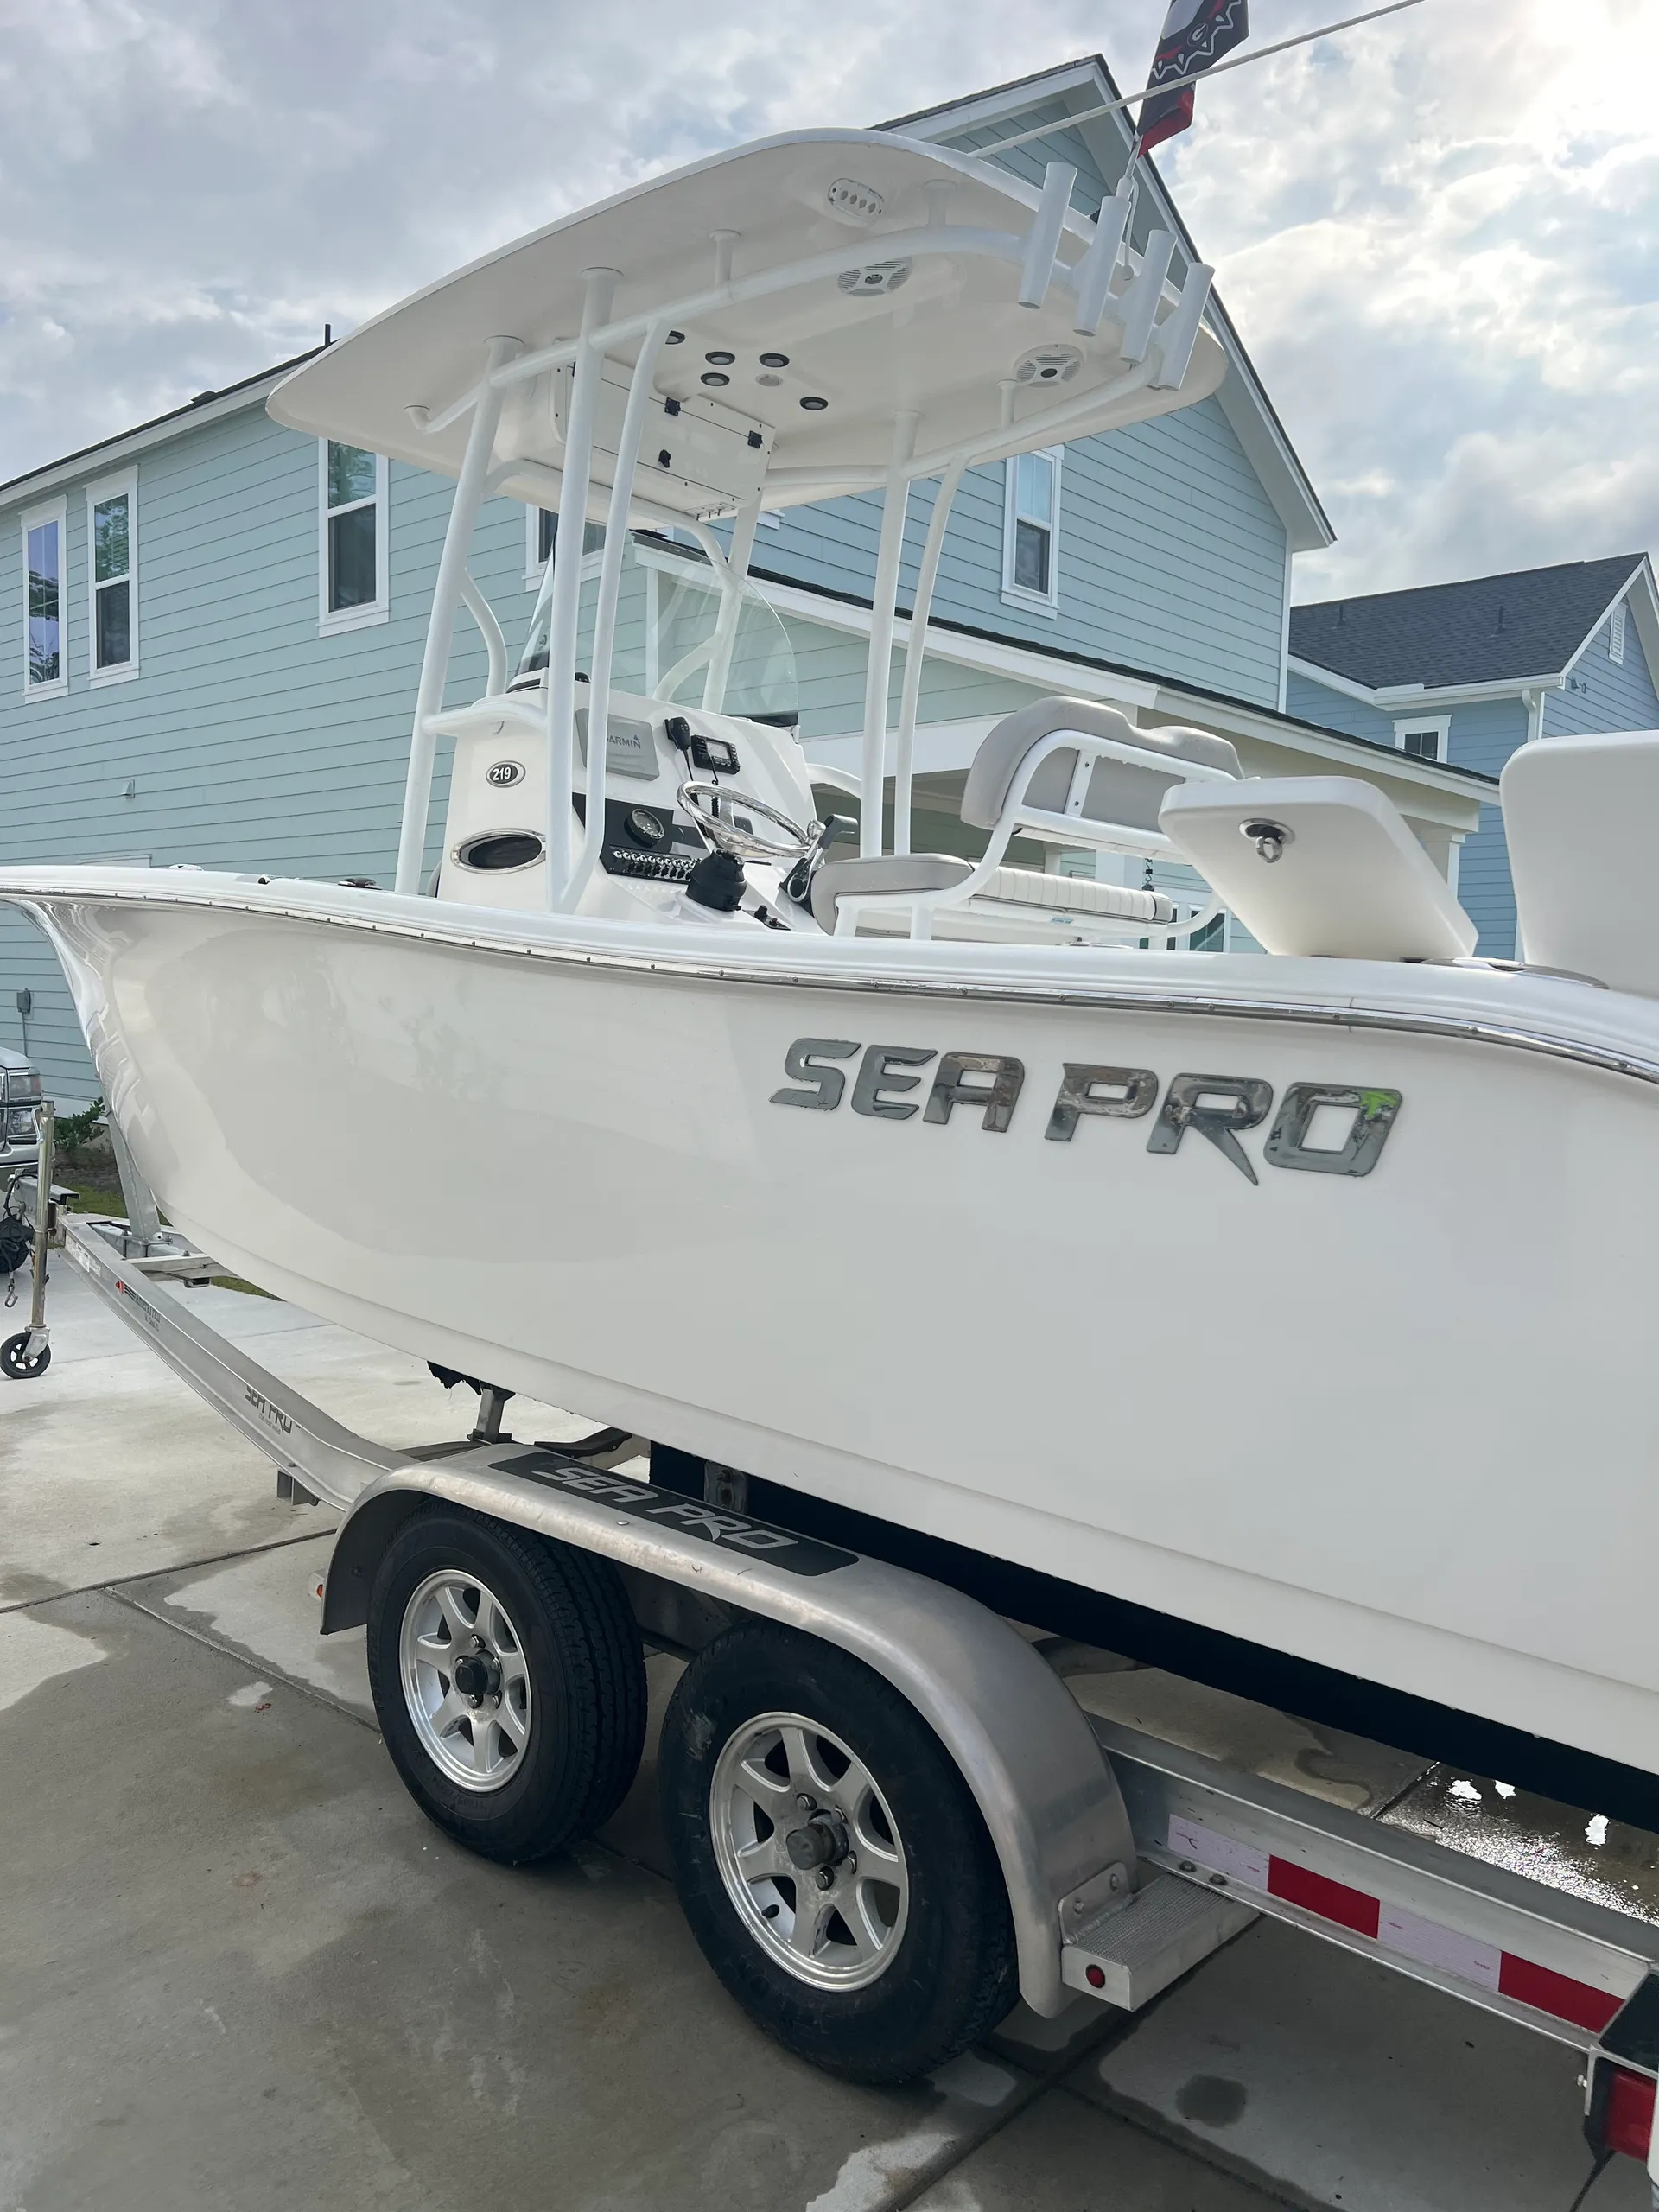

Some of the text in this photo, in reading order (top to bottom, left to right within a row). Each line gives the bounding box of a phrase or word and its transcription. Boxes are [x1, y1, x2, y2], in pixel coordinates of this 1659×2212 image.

[493, 766, 512, 781] 219
[768, 1037, 1402, 1186] SEA PRO
[245, 1385, 266, 1414] SEA
[268, 1403, 293, 1436] PRO
[531, 1467, 799, 1549] SEA PRO
